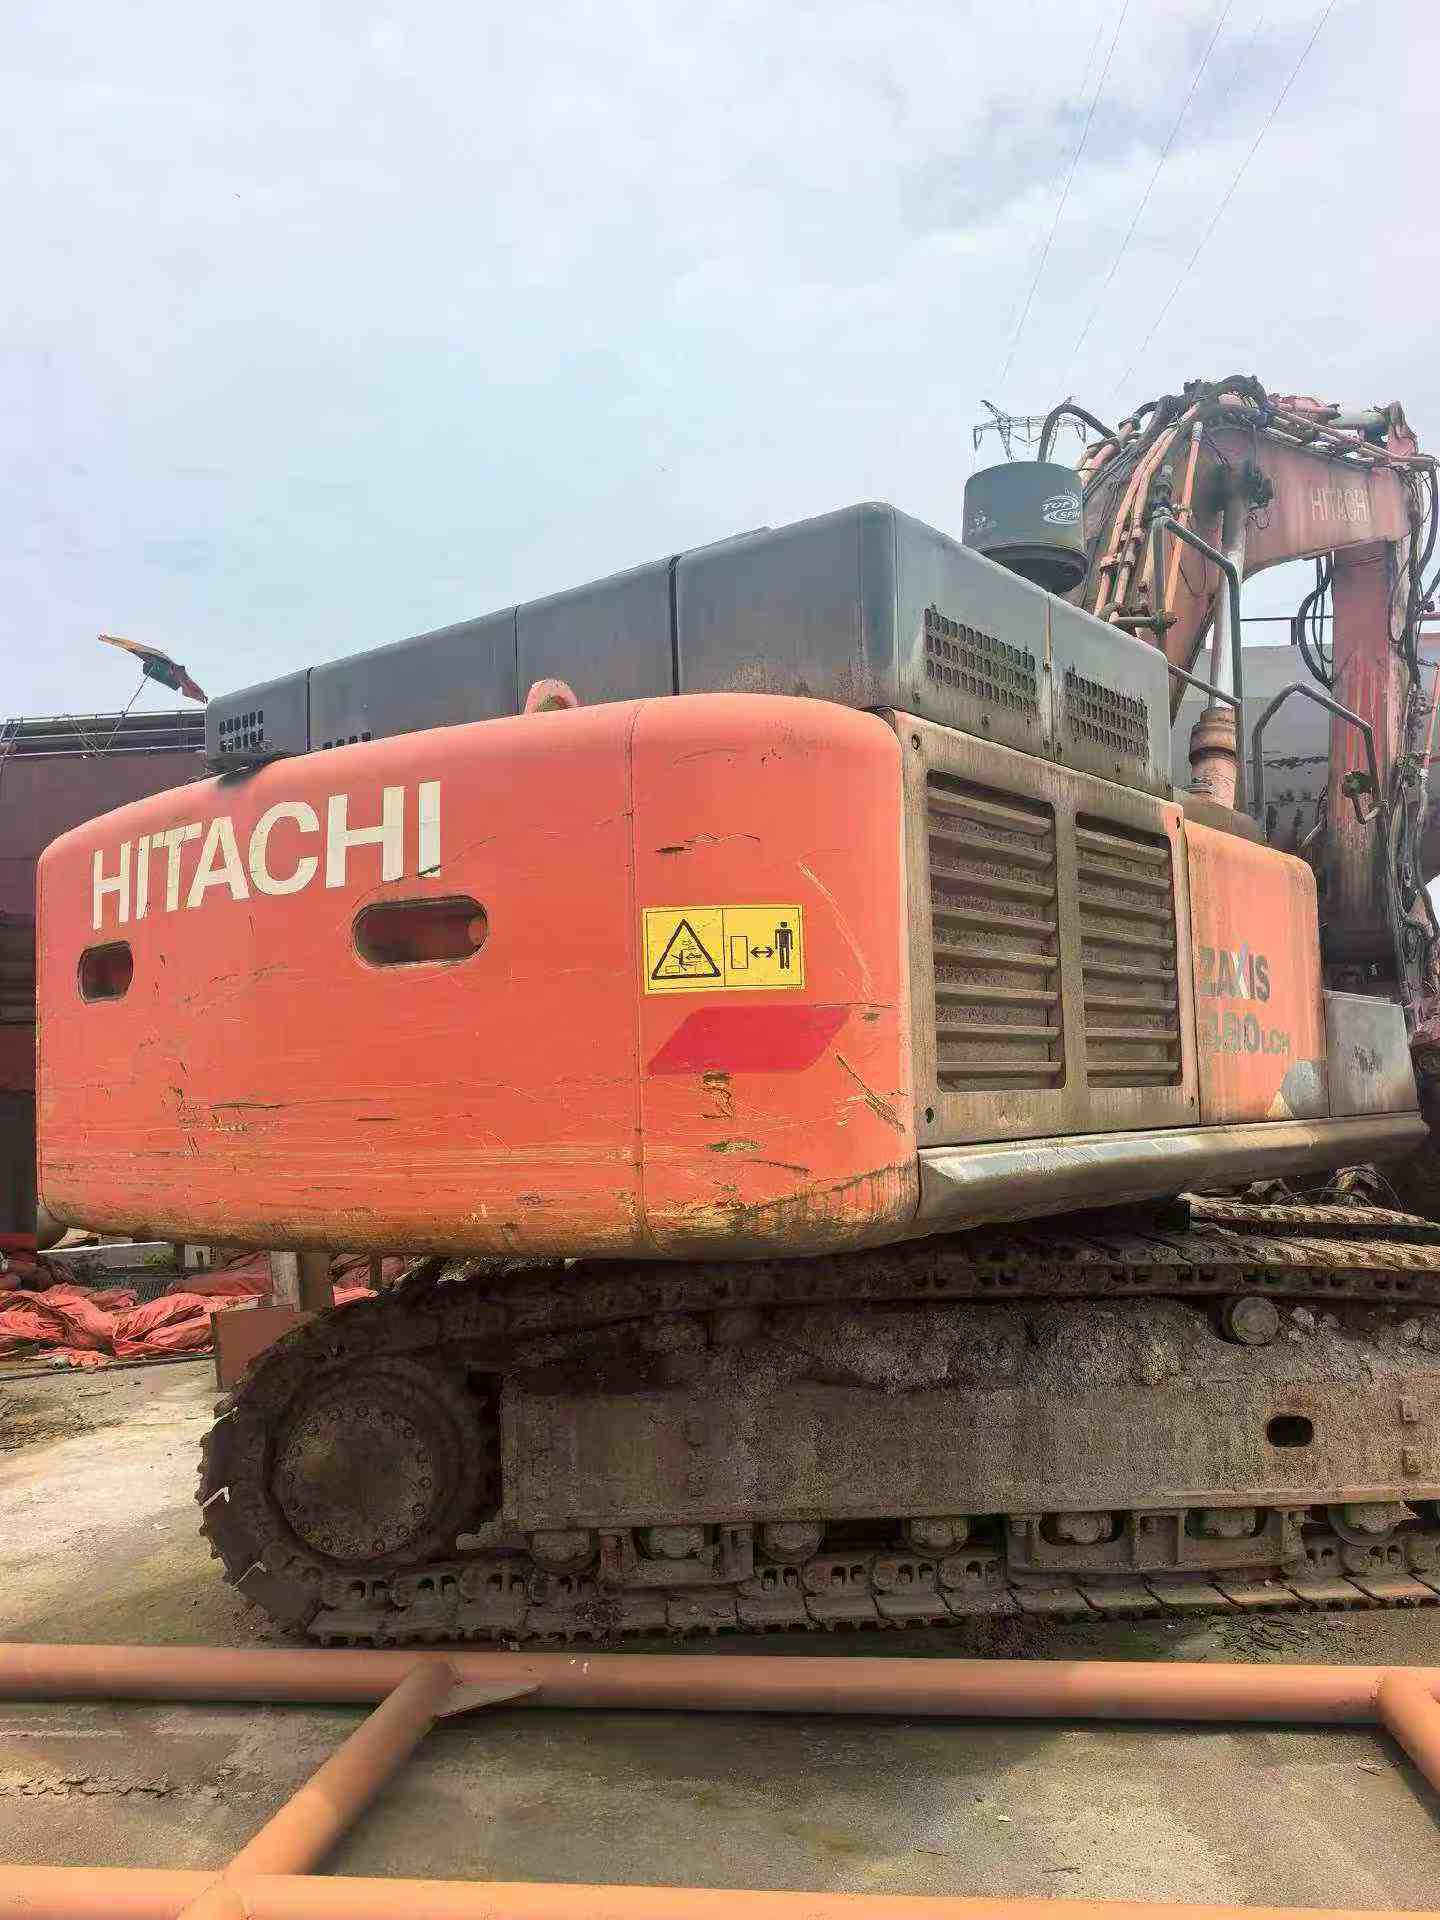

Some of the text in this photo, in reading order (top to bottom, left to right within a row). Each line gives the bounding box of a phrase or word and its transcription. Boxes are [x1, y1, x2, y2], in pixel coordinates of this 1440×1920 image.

[1312, 488, 1369, 521] HITACHI
[93, 781, 440, 930] HITACHI
[1199, 941, 1271, 1003] ZAXIS
